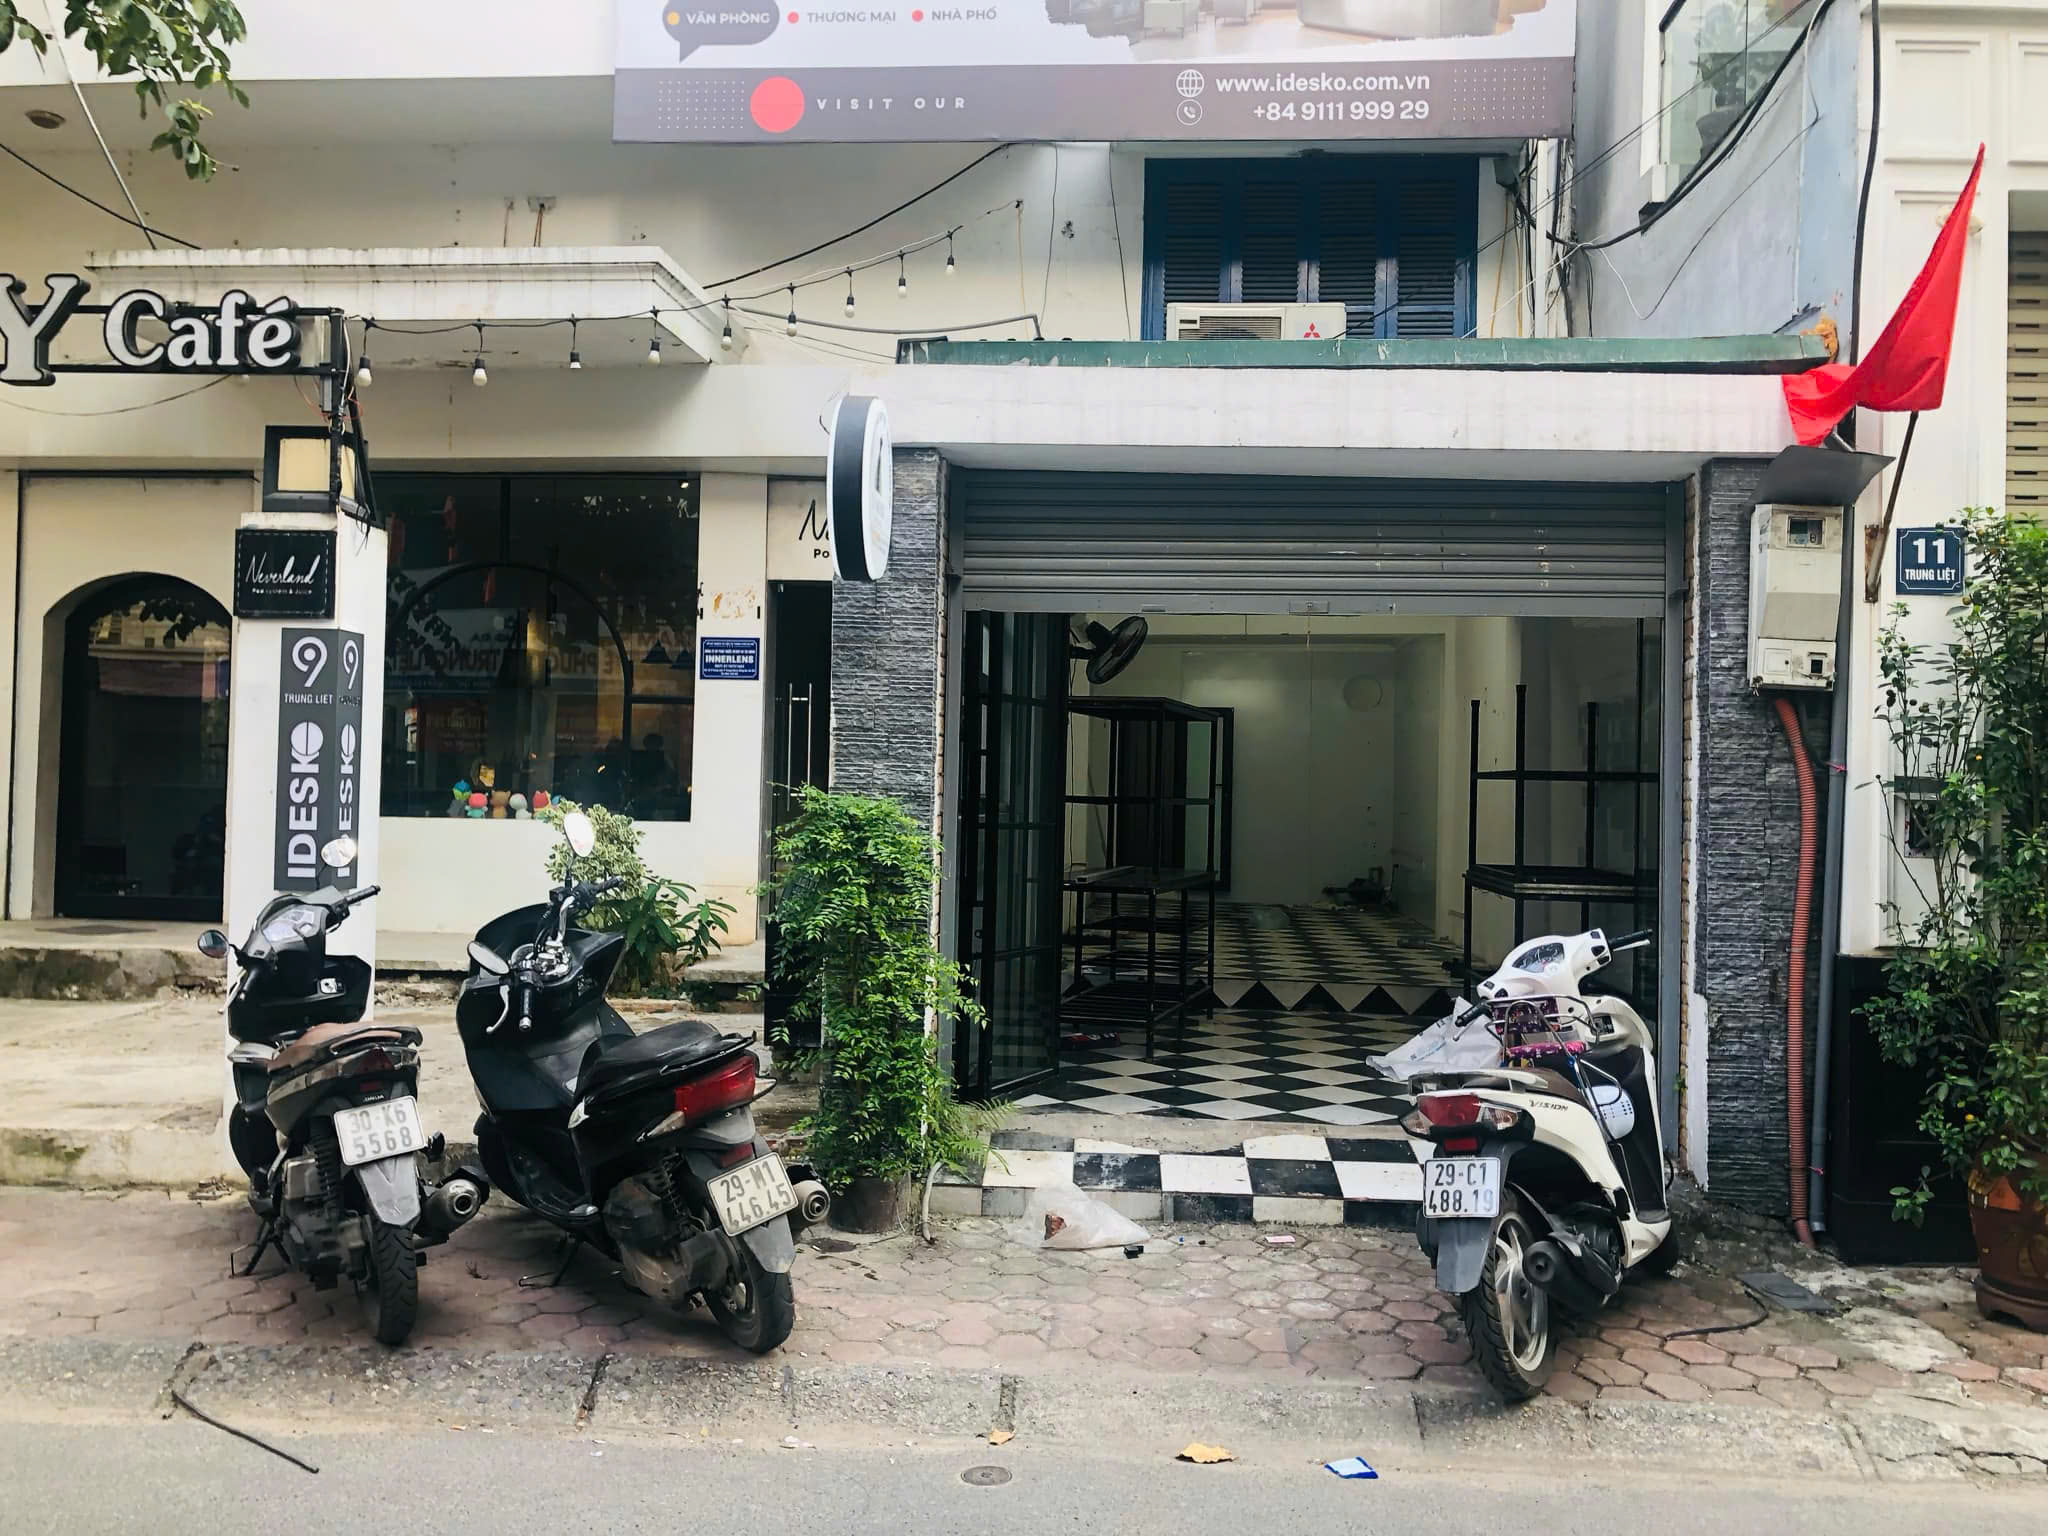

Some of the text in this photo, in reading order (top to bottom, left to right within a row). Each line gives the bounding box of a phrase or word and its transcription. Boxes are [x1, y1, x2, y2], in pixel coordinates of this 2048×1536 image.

[686, 9, 771, 25] VĂN PHÒNG
[931, 5, 998, 21] NHÀ PHỐ
[1215, 72, 1431, 92] www.idesko.com.vn
[816, 97, 966, 110] VISIT OUR
[1253, 100, 1430, 121] +84 9111 999 29
[104, 289, 302, 369] Café
[1913, 537, 1946, 564] 11
[245, 551, 321, 584] Neverland
[1904, 566, 1956, 584] TRUNG LIỆT
[292, 636, 328, 688] 9
[343, 639, 359, 690] 9
[315, 693, 334, 705] LIET
[287, 721, 324, 878] IDESKO
[337, 723, 357, 878] IESKO
[1529, 1099, 1568, 1111] VISION
[353, 1126, 412, 1158] 5568
